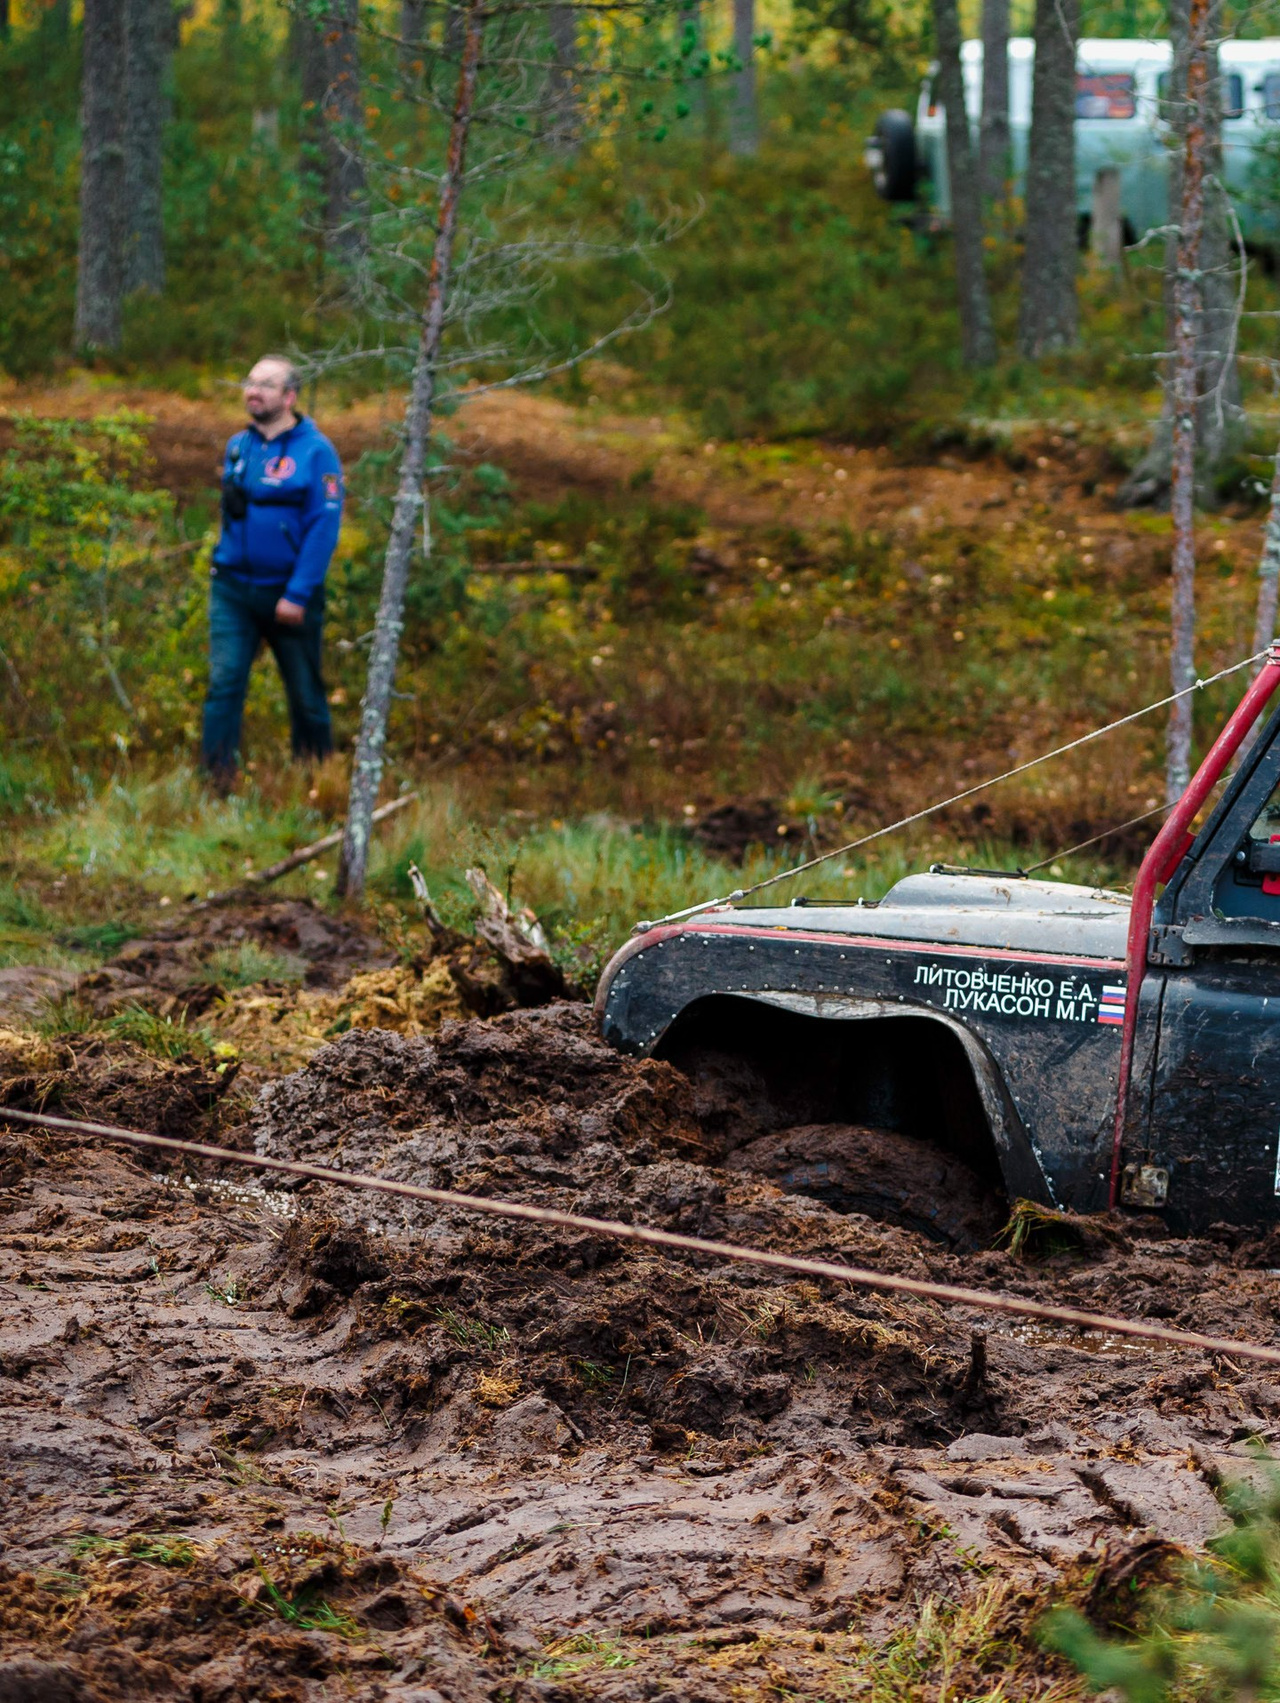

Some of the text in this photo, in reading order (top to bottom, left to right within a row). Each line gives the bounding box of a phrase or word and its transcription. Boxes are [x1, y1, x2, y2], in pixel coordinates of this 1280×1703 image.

[914, 966, 1098, 1002] ЛИТОВЧЕНКО Е.А.
[943, 988, 1096, 1023] ЛУКАСОН М.Г.
